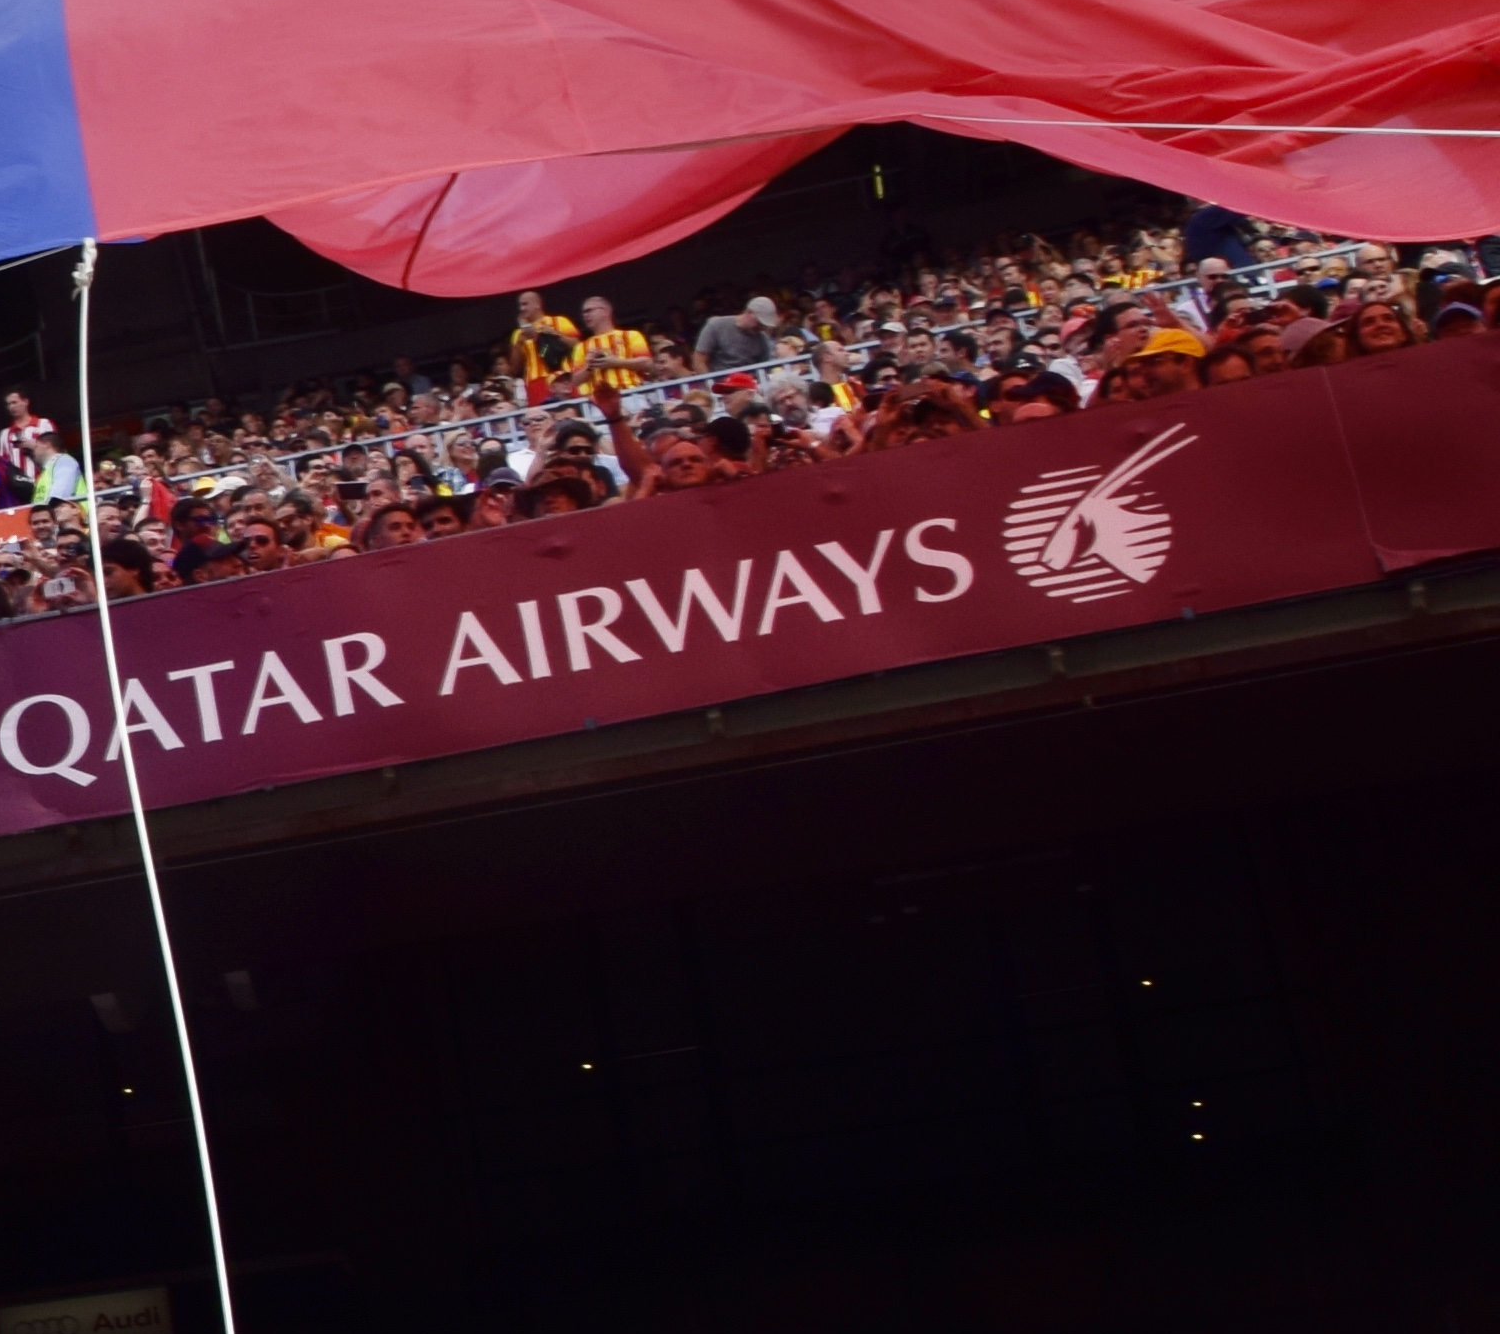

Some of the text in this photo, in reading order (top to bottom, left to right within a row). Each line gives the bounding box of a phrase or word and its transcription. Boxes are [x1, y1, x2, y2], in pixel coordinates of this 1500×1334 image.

[0, 517, 974, 787] QATAR AIRWAYS
[92, 1305, 161, 1333] Audi
